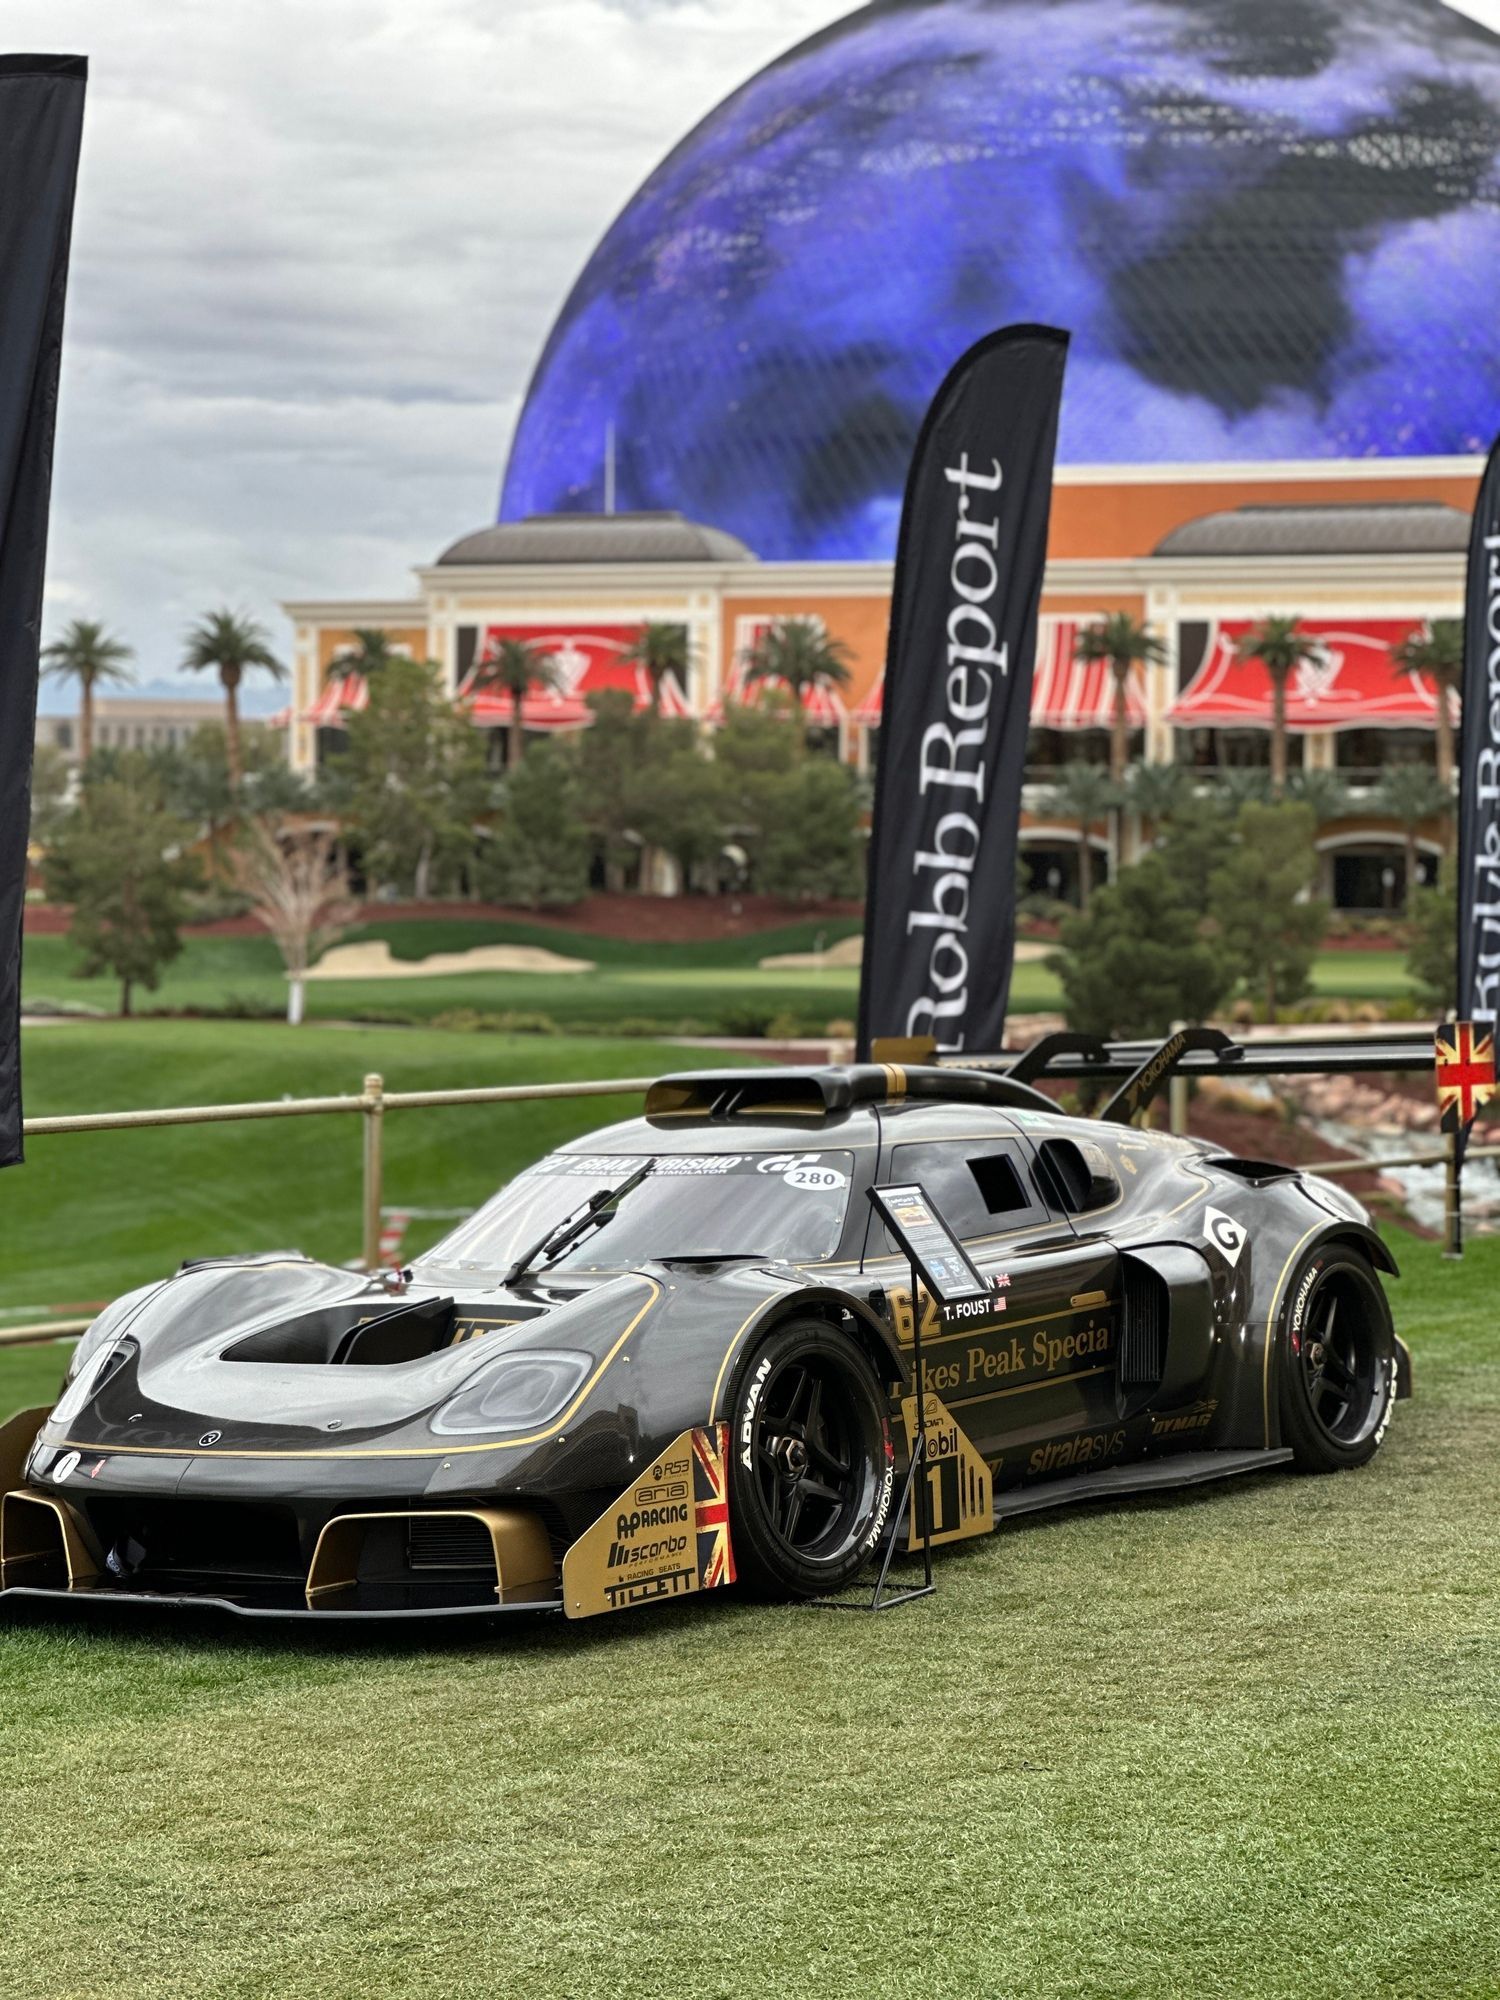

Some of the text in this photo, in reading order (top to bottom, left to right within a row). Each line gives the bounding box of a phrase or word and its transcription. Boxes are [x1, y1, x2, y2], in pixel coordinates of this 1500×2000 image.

[919, 451, 1008, 802] Report
[907, 811, 980, 1052] Robb
[1137, 1033, 1187, 1092] YOKOHAMA
[574, 1157, 633, 1170] GRAN
[795, 1172, 836, 1185] 280
[1211, 1217, 1241, 1251] G
[888, 1279, 942, 1343] 62
[943, 1299, 991, 1321] T. FOUST
[1292, 1267, 1318, 1332] YOKOHAMA
[966, 1337, 1026, 1382] Peak
[740, 1357, 772, 1472] ADVAN
[1151, 1413, 1212, 1435] DYMAG
[664, 1459, 690, 1477] R53
[1026, 1429, 1127, 1475] stratasys
[638, 1483, 686, 1502] aria
[865, 1466, 894, 1549] YOKOHAMA
[926, 1464, 943, 1530] 1
[604, 1567, 696, 1607] TILLETT
[627, 1562, 681, 1581] RACING SEATS
